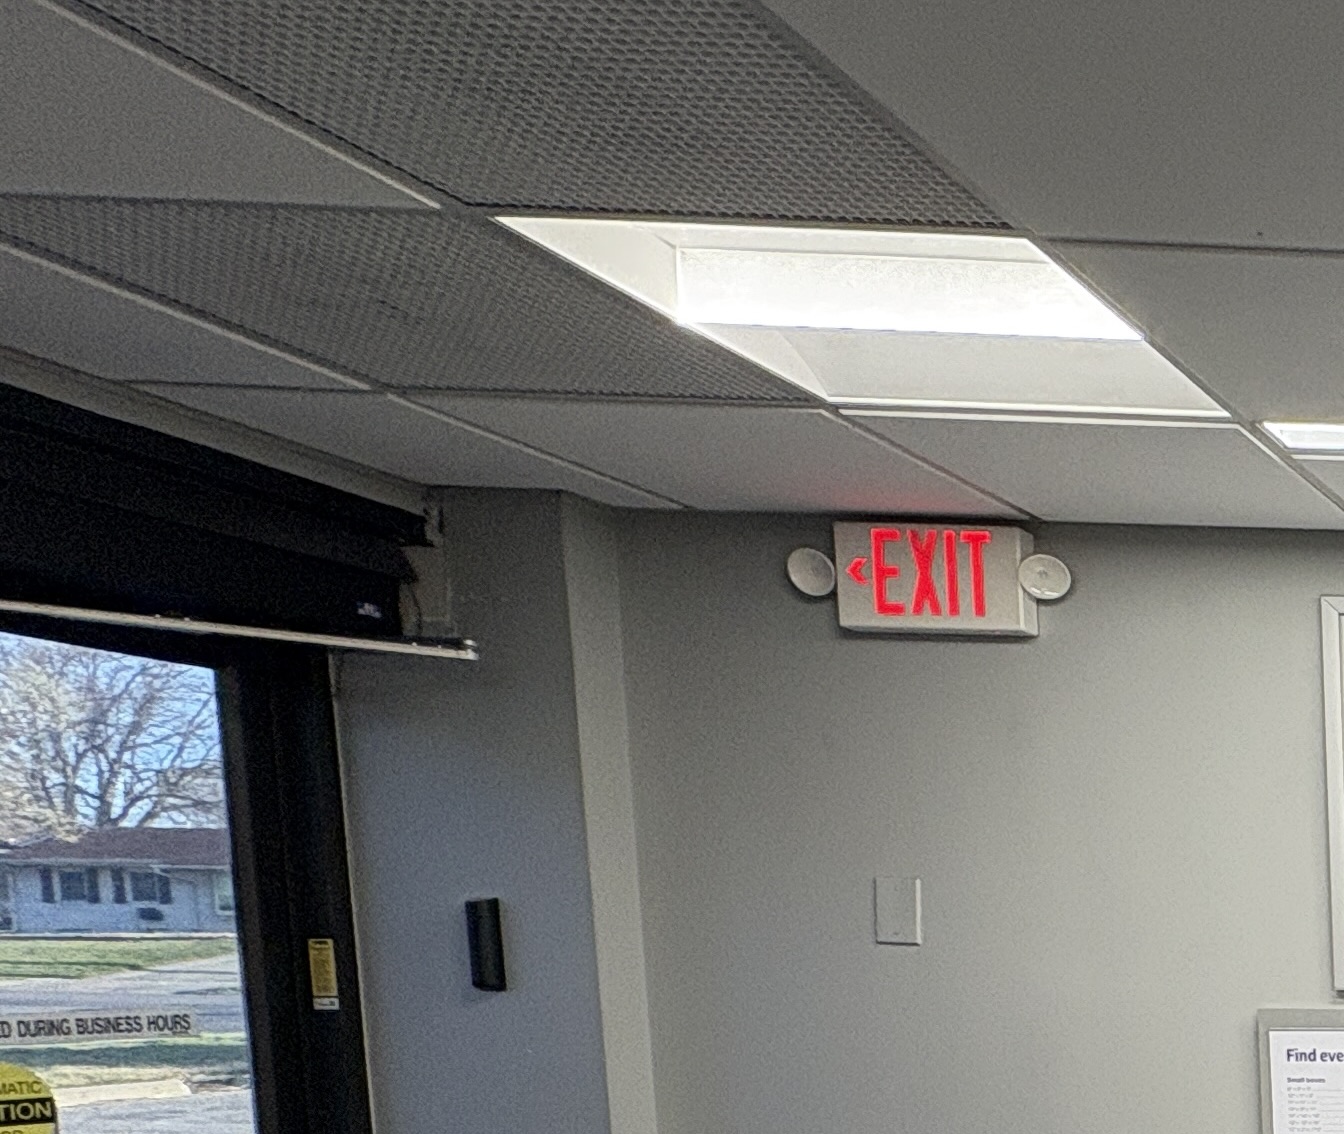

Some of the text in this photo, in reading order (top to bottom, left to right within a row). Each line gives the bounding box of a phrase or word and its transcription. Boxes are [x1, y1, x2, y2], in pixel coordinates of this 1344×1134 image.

[871, 527, 993, 617] EXIT
[17, 1018, 71, 1037] DURING
[75, 1016, 143, 1034] BUSINESS
[147, 1014, 191, 1032] HOURS
[1286, 1049, 1317, 1062] Find
